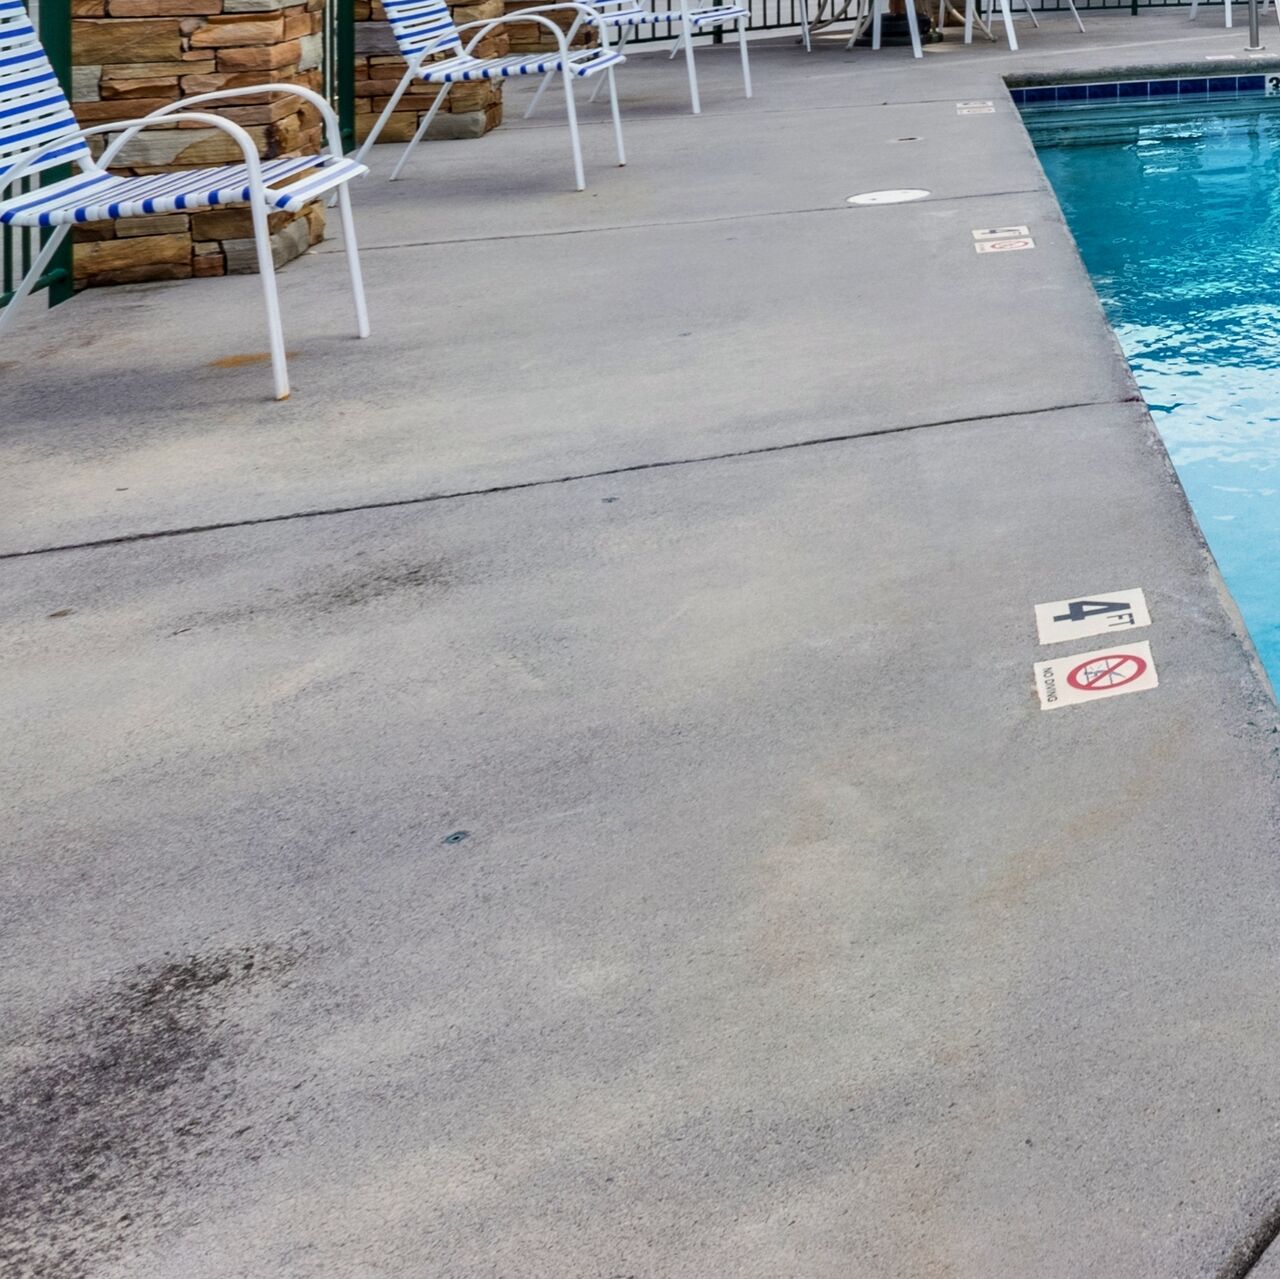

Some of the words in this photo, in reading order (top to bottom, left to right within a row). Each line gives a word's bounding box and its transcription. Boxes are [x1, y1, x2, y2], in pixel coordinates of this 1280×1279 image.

[1053, 600, 1131, 623] 4
[1043, 667, 1054, 678] NO
[1044, 679, 1058, 703] DIVING
